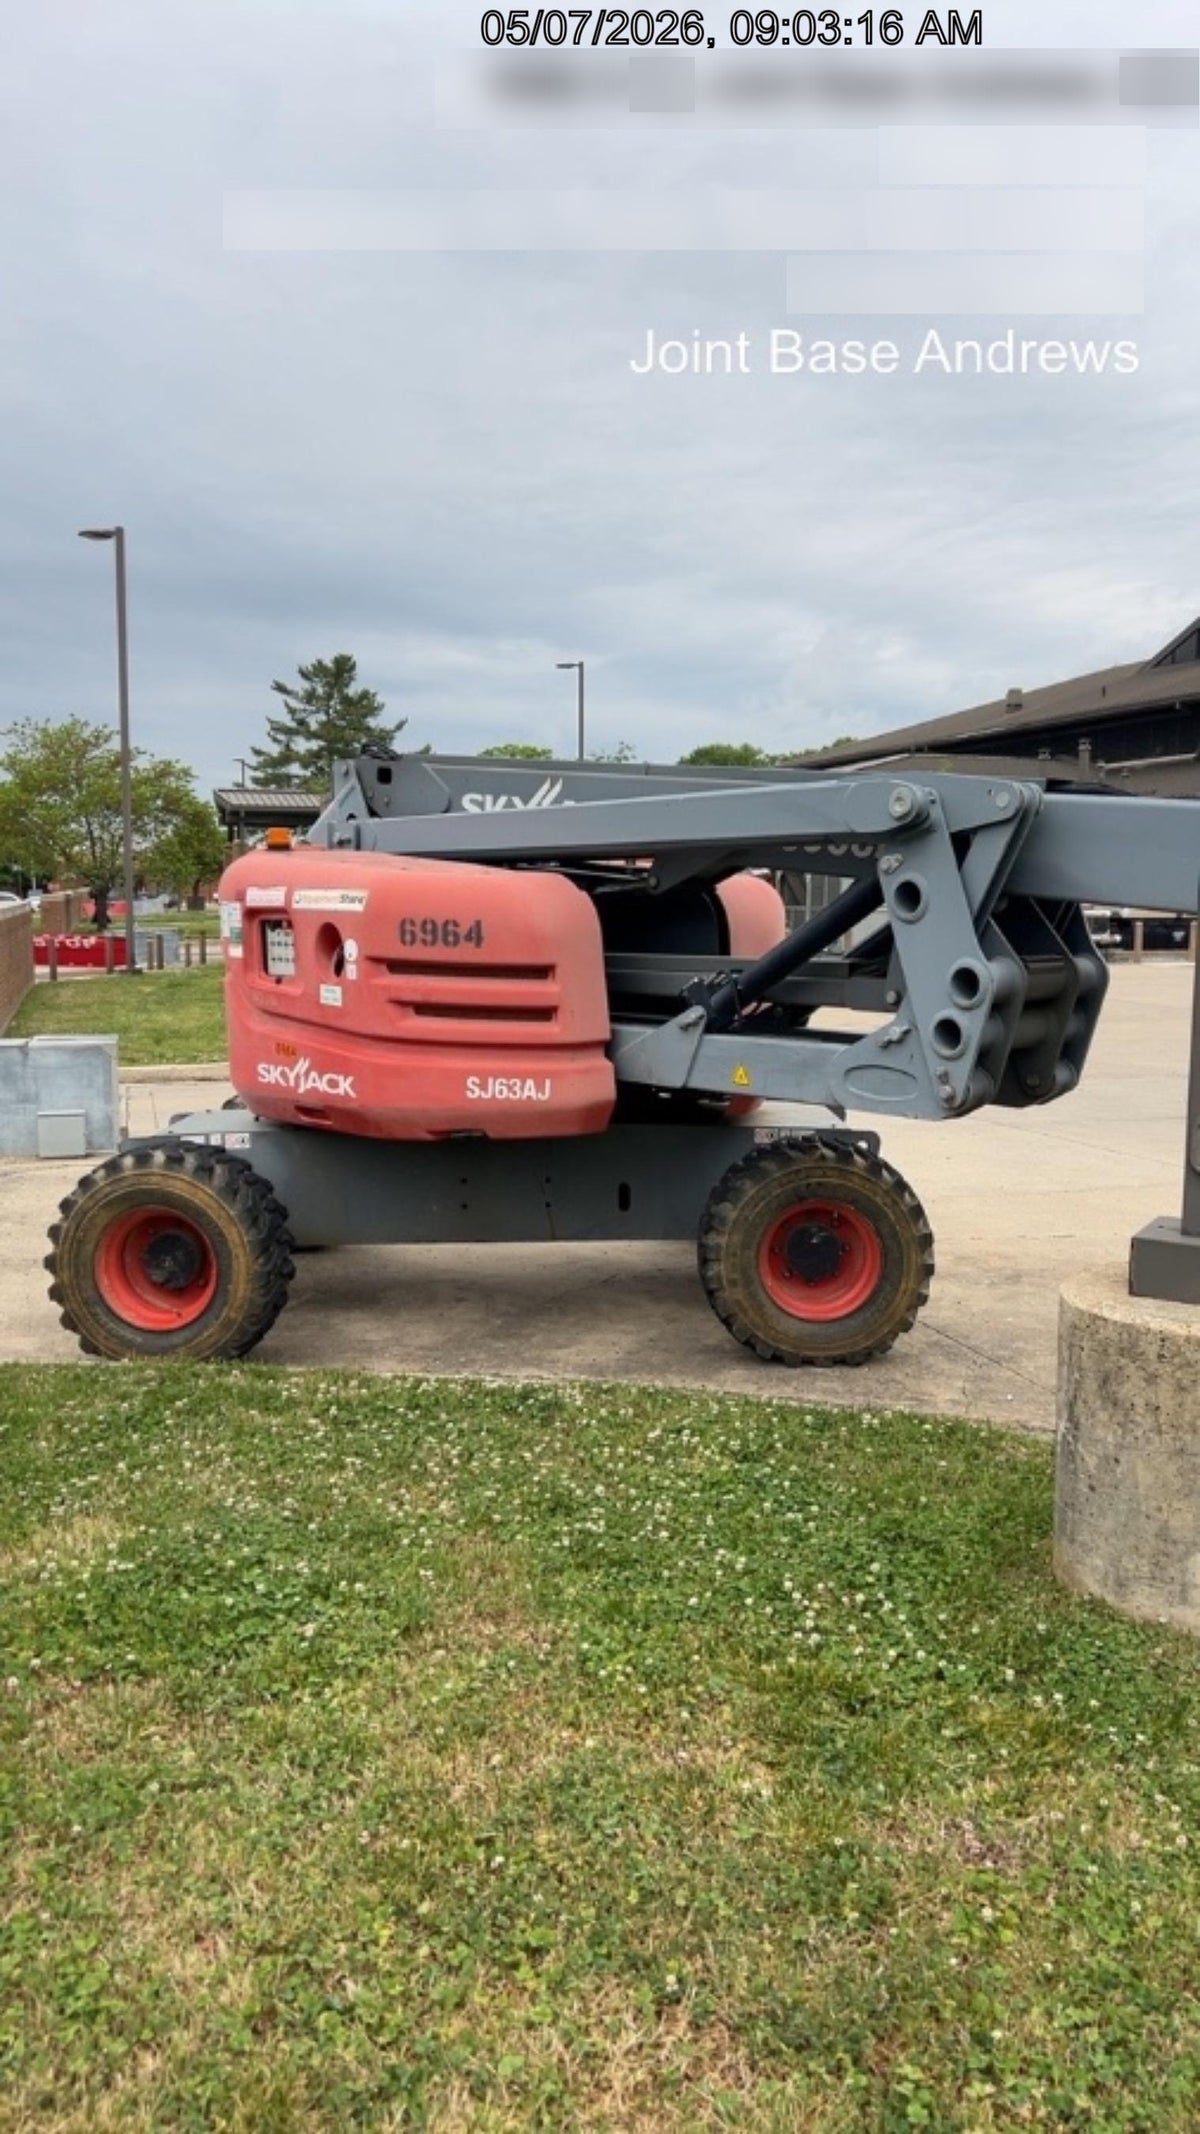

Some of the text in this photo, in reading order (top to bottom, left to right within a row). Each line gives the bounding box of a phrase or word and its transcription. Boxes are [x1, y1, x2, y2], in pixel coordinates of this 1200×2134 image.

[398, 916, 485, 949] 6964
[257, 1056, 357, 1098] SKYJACK
[465, 1075, 552, 1101] SJ63AJ
